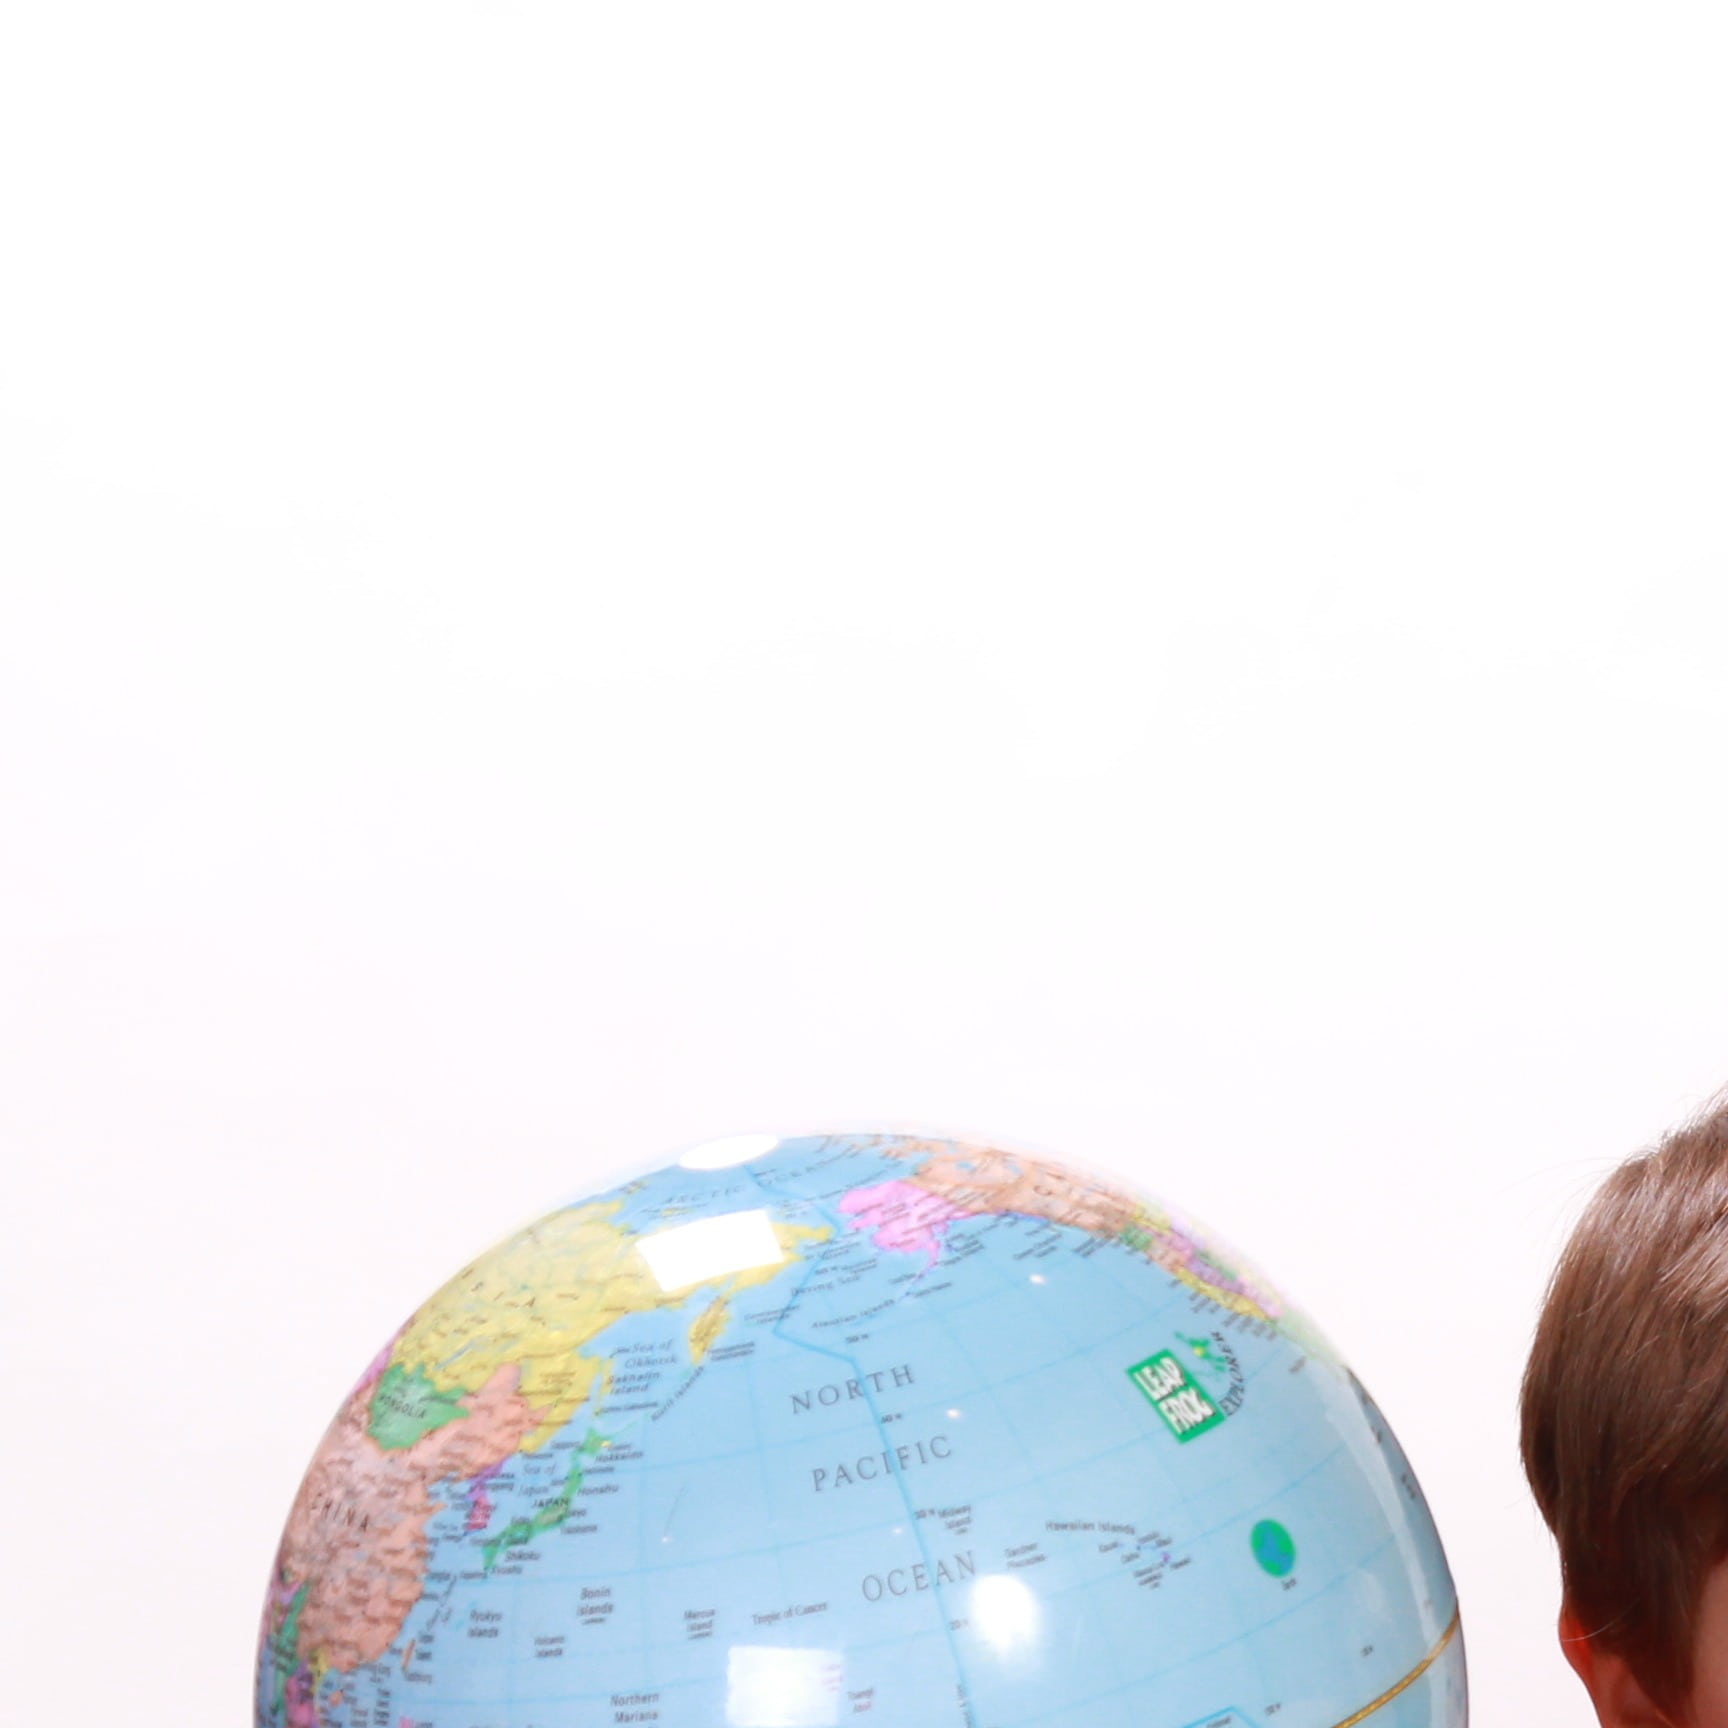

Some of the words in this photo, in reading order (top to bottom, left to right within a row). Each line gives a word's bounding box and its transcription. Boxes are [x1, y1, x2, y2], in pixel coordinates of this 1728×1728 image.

[789, 1362, 916, 1415] NORTH
[1132, 1355, 1188, 1401] LEAP
[1157, 1386, 1217, 1436] FROG
[812, 1434, 952, 1494] PACIFIC
[862, 1549, 977, 1603] OCEAN
[609, 1692, 660, 1707] Northern
[613, 1709, 659, 1724] Mariana
